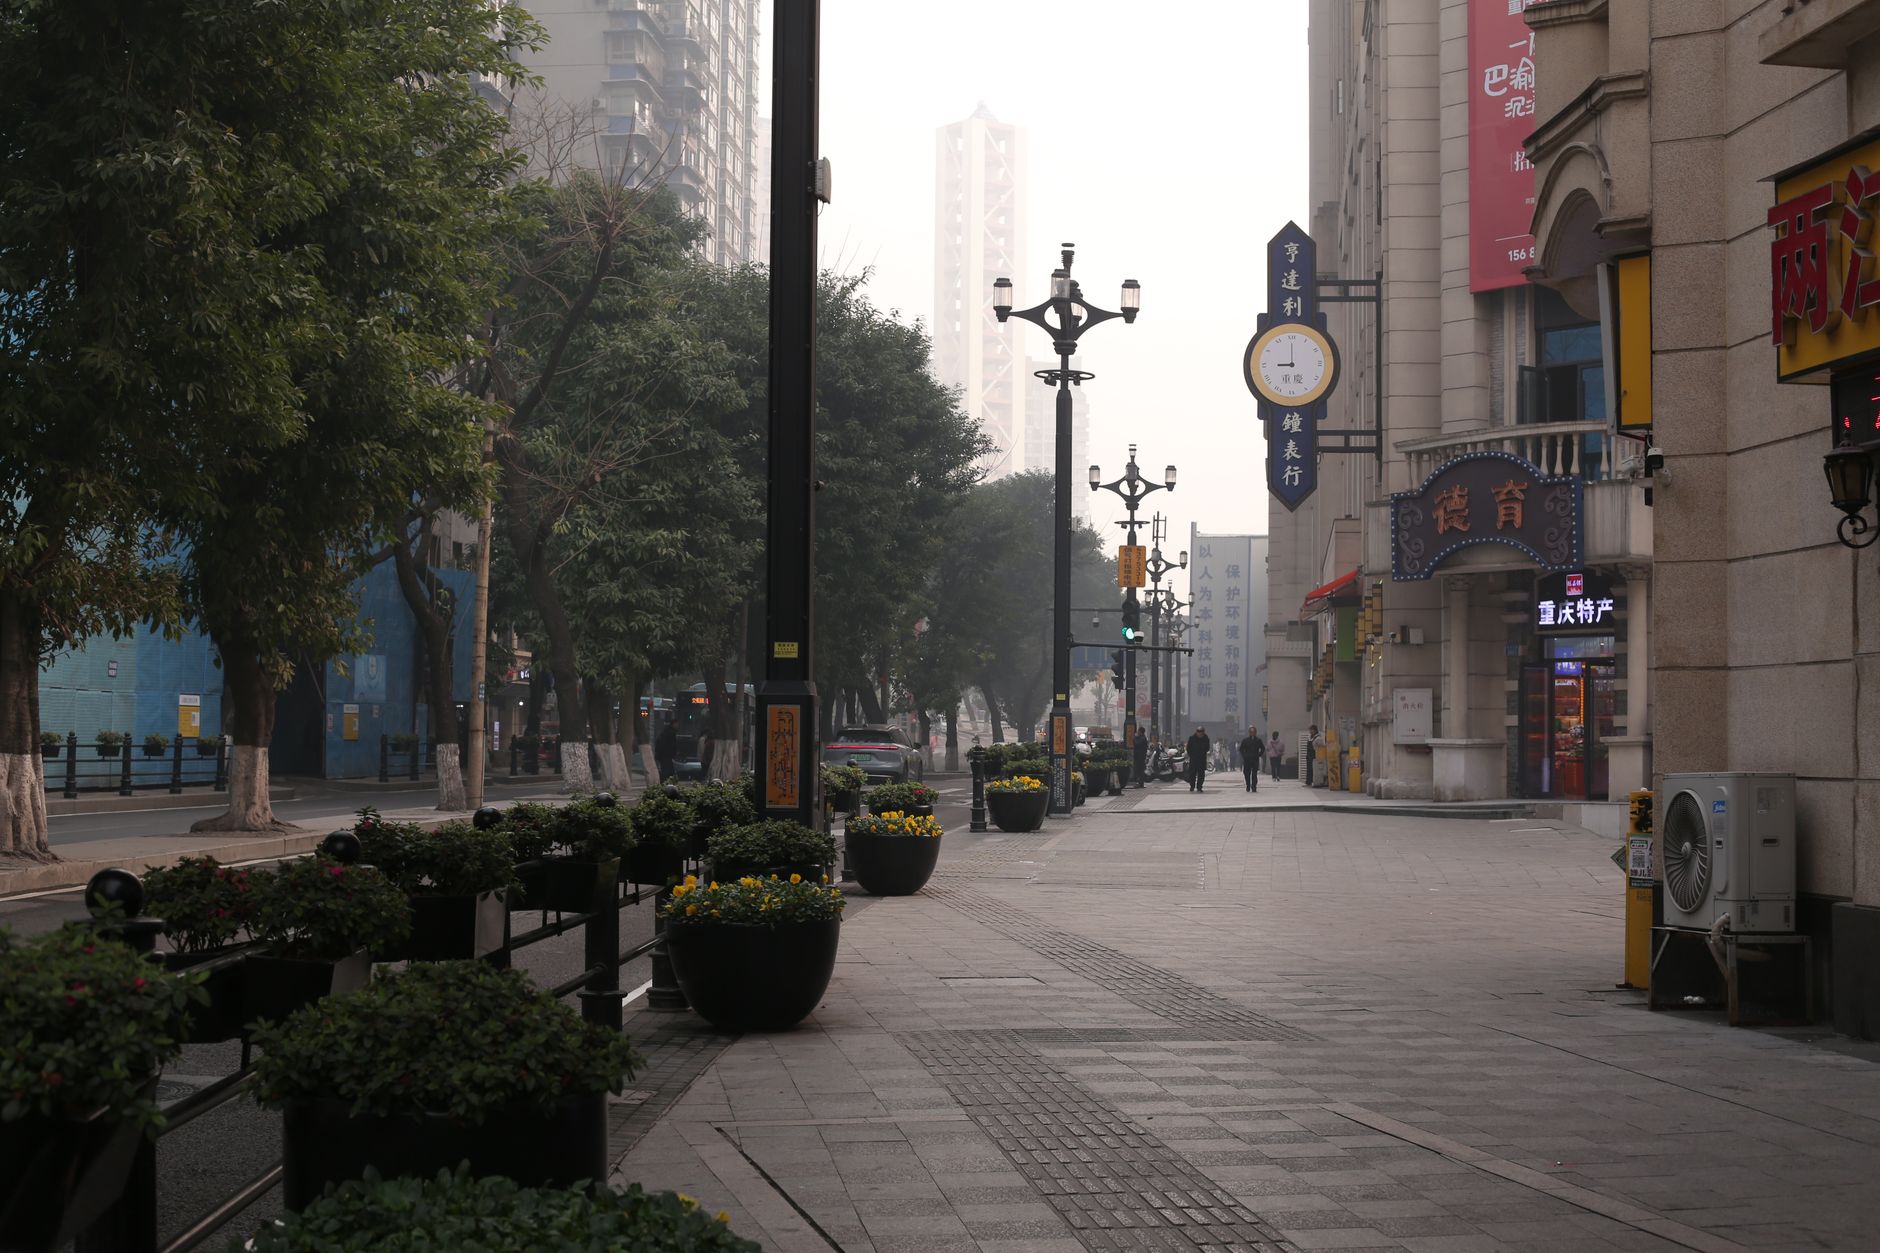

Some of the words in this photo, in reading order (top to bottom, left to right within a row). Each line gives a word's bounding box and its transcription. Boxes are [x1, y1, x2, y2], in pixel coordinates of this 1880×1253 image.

[1483, 57, 1535, 97] 巴渝
[1281, 241, 1303, 318] 亨達利
[1508, 249, 1526, 262] 156
[1281, 412, 1304, 488] 鐘表行
[1432, 479, 1529, 535] 德育
[1538, 596, 1614, 626] 重庆特产
